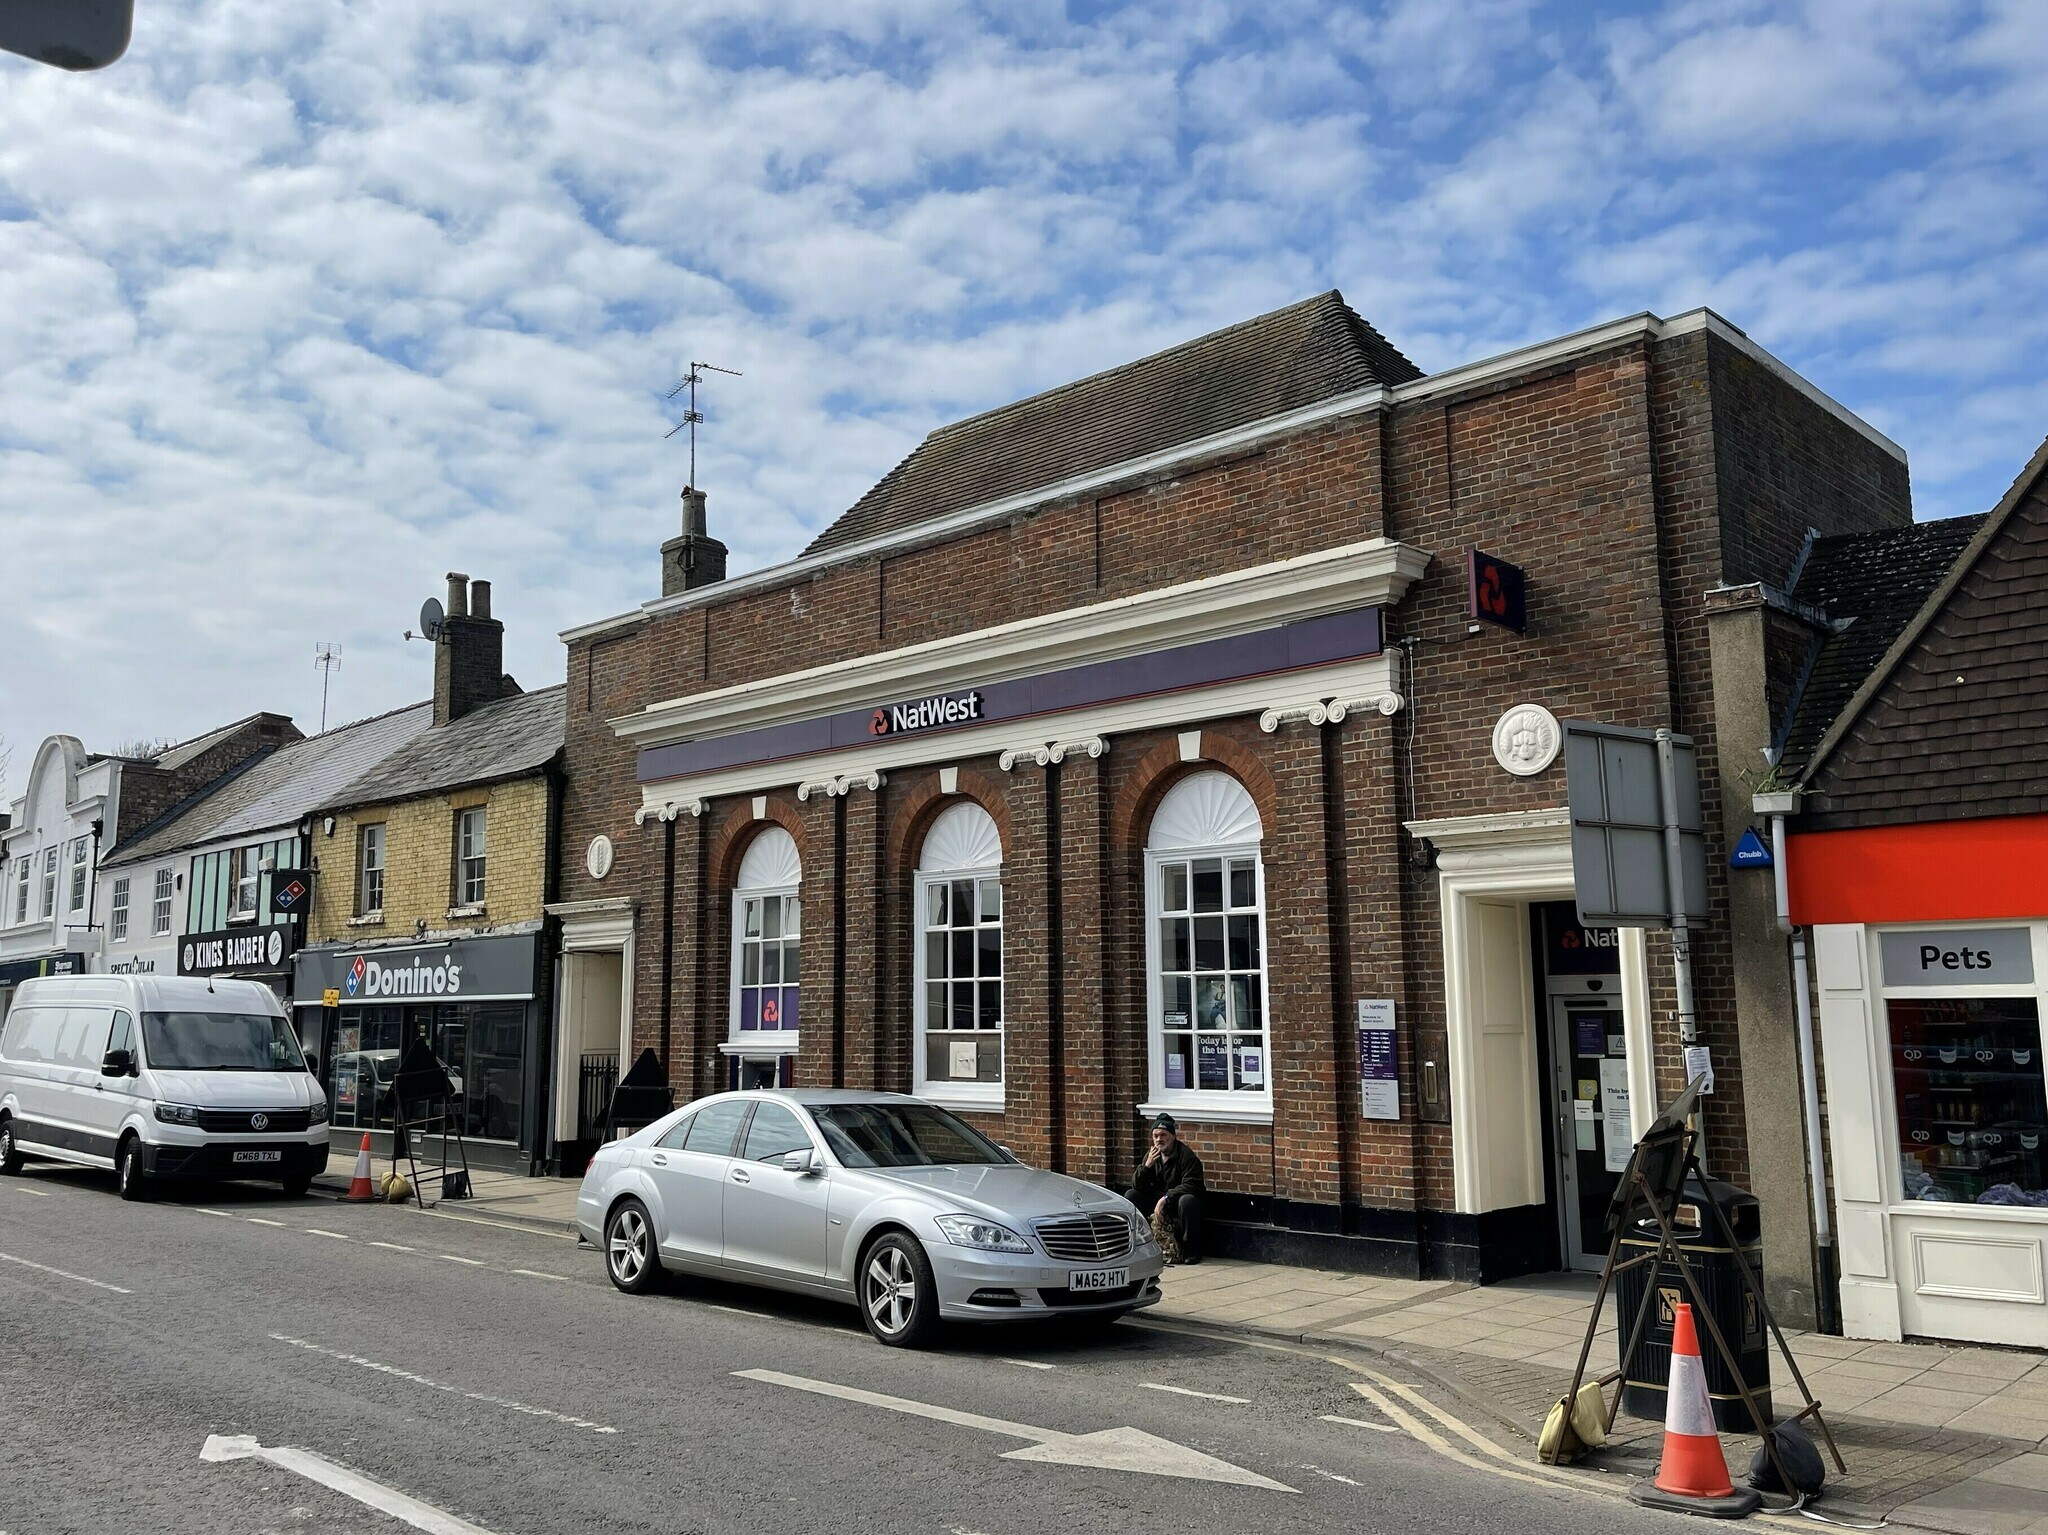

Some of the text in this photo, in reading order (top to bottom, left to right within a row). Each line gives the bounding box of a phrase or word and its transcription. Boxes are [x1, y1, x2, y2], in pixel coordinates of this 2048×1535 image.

[893, 691, 978, 732] NatWest
[1738, 850, 1762, 859] Chubb
[196, 935, 265, 968] KINGS BARBER
[1920, 945, 1992, 970] Pets
[110, 955, 155, 975] SPECTACULAR
[364, 954, 461, 996] Domino's
[1202, 1046, 1216, 1054] the
[1904, 1050, 1922, 1062] QD
[1975, 1050, 1994, 1062] QD
[1911, 1130, 1930, 1142] QD
[1982, 1133, 2002, 1145] QD
[261, 1151, 278, 1160] TXL
[1075, 1273, 1106, 1288] MA62
